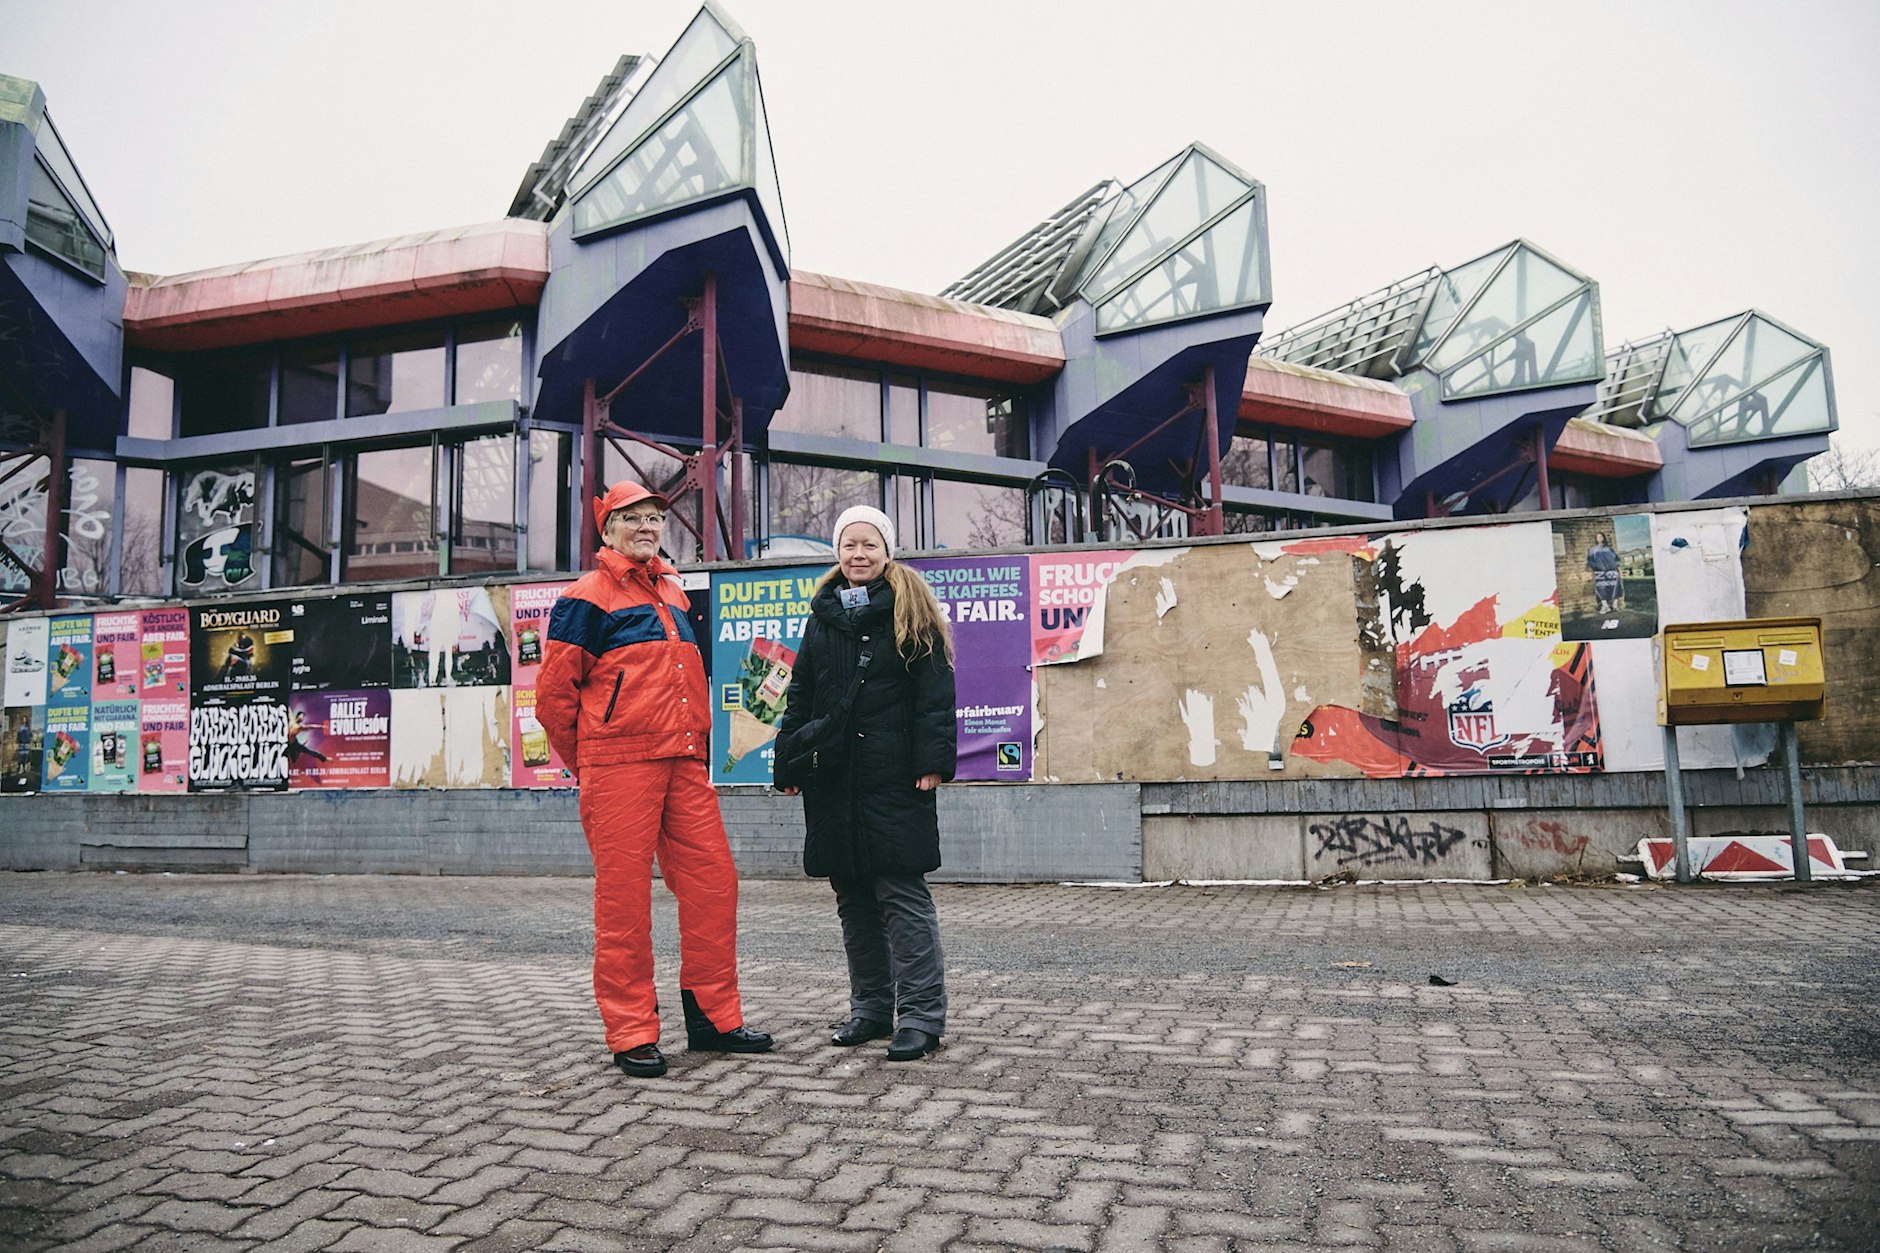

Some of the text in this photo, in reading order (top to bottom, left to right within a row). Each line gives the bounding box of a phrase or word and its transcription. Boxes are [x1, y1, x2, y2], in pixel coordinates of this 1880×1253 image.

[987, 567, 1021, 581] WIE
[719, 579, 793, 604] DUFTE
[948, 583, 1023, 599] KAFFEES.
[516, 608, 541, 620] UND
[719, 602, 784, 620] ANDERE
[956, 600, 1025, 623] FAIR.
[142, 612, 186, 625] KÖSTLICH
[200, 609, 281, 628] BODYGUARD
[718, 618, 783, 643] ABER
[96, 633, 116, 643] UND
[94, 703, 137, 714] NATÜRLICH
[329, 701, 368, 719] BALLET
[955, 705, 1025, 719] #fairbruary
[142, 721, 188, 732] UND FAIR.
[329, 713, 389, 736] EVOLUCIÓN
[985, 718, 1007, 726] Monat
[977, 725, 1012, 734] einkaufen
